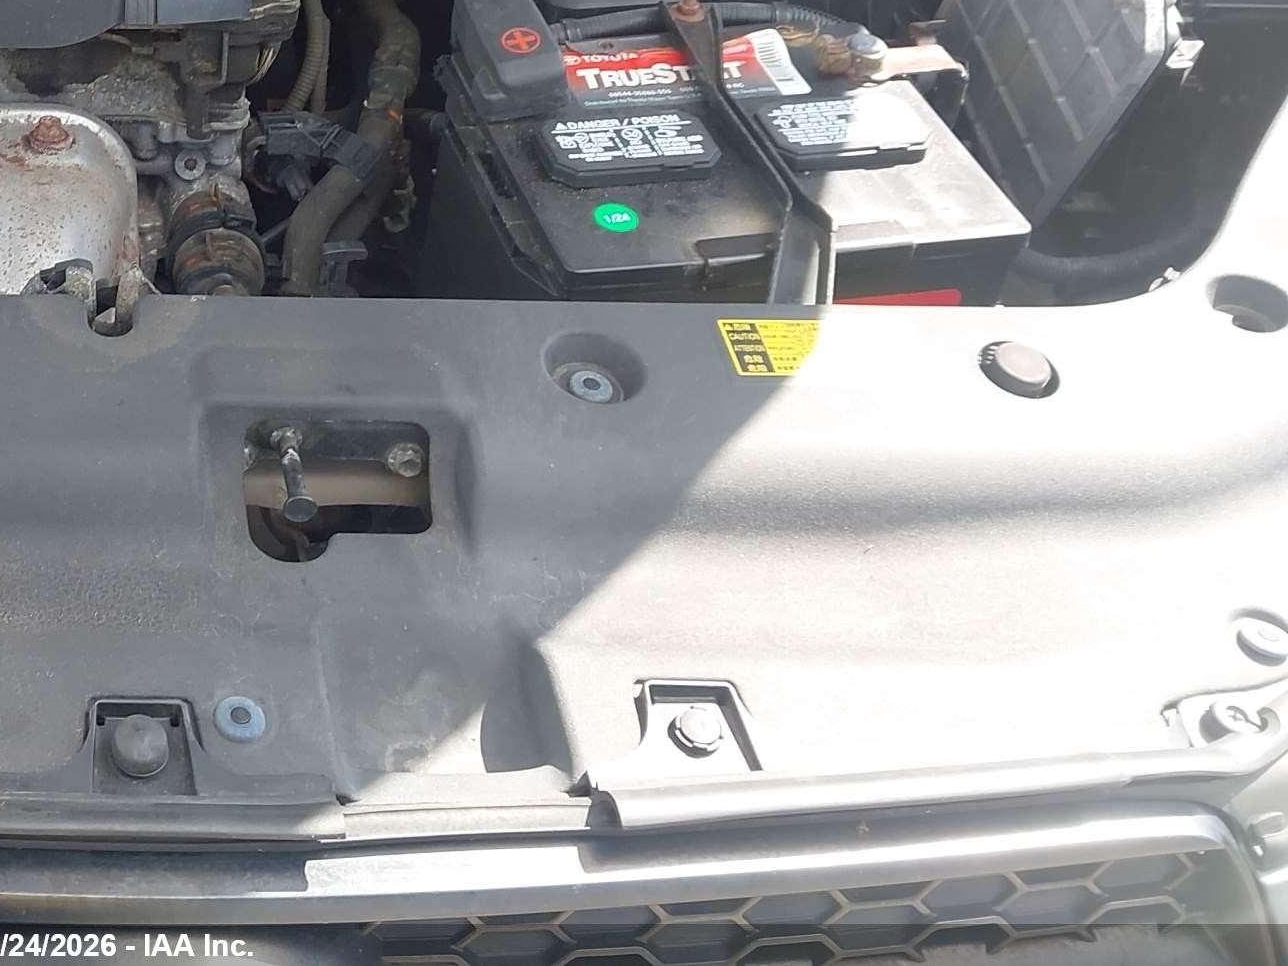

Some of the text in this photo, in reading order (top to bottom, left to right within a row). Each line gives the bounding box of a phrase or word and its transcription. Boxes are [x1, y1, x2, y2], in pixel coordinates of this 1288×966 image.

[581, 53, 639, 63] TOYOTA
[566, 119, 621, 130] DANGER
[631, 114, 680, 125] POISON
